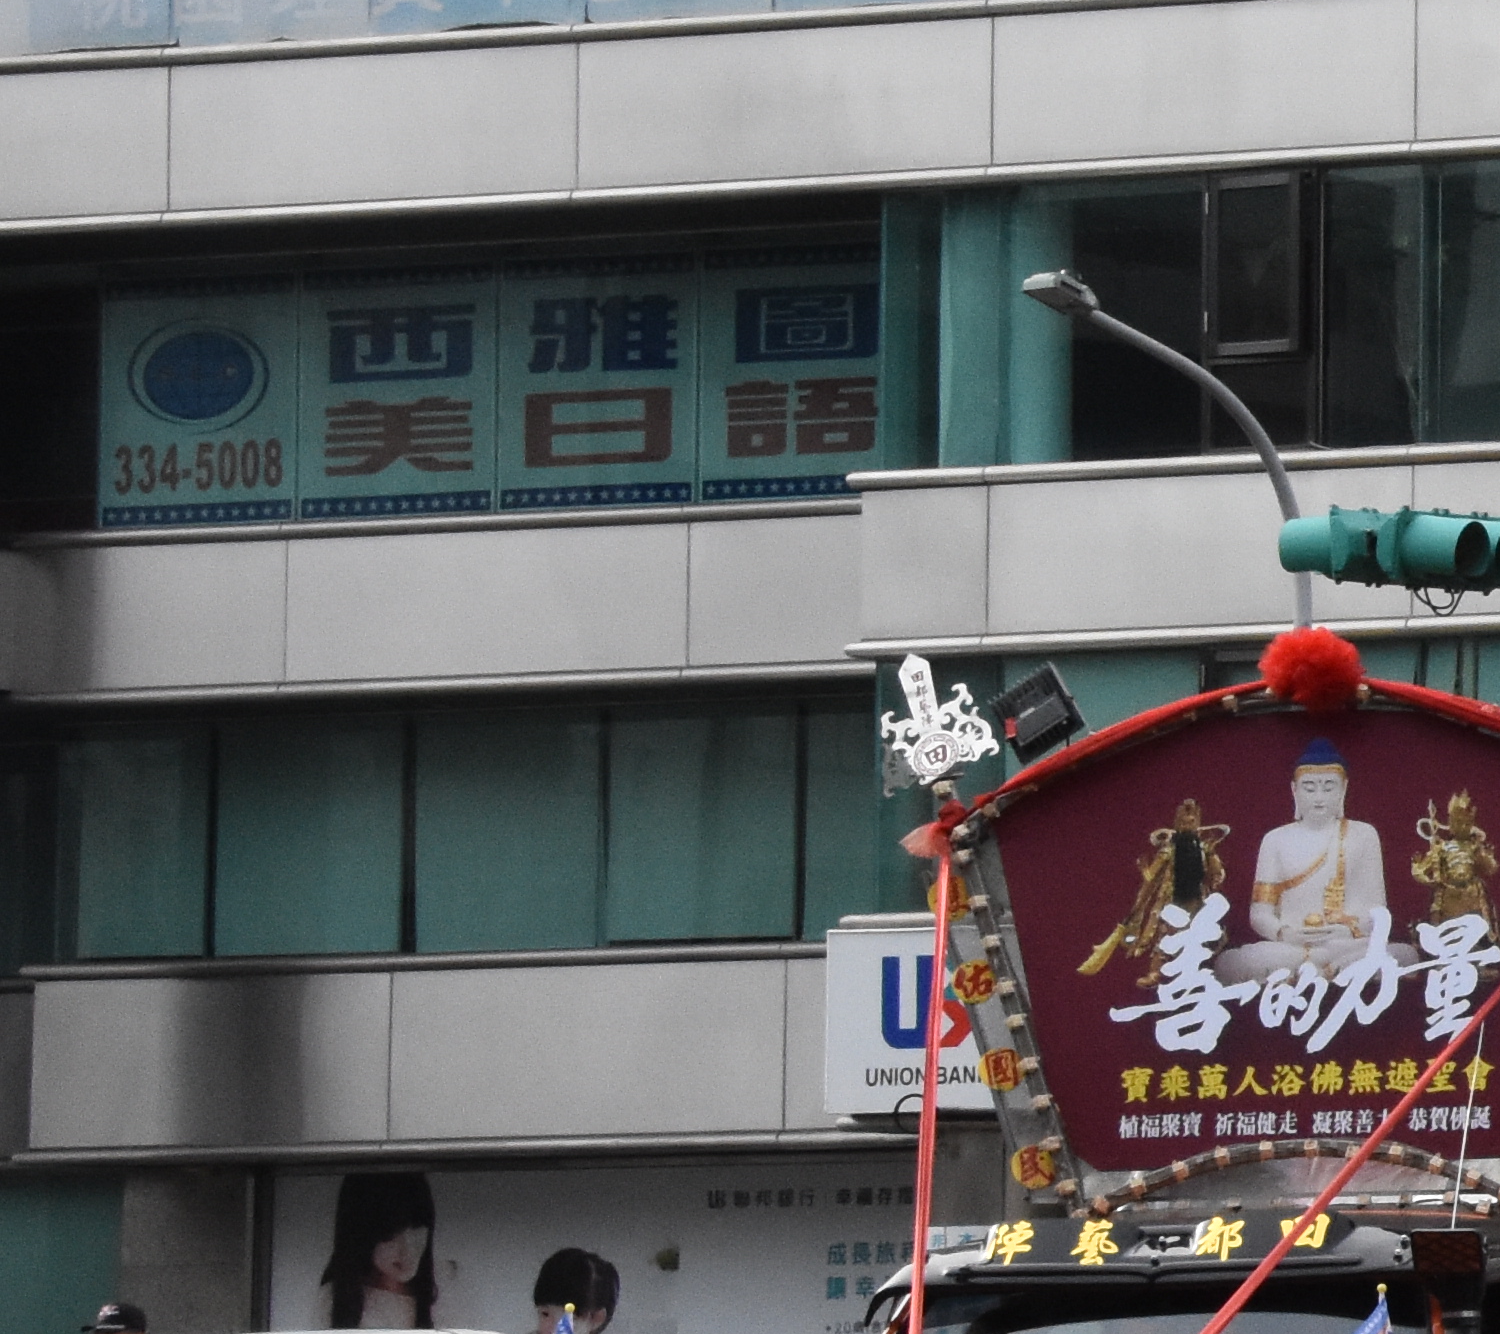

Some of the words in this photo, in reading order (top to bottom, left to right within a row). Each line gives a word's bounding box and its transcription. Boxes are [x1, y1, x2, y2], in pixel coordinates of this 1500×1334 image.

[326, 282, 882, 385] 西雅圖
[324, 376, 881, 478] 美日語
[113, 437, 284, 497] 334-5008
[935, 1065, 982, 1086] BAN
[1214, 1110, 1299, 1138] 祈福健走
[1407, 1104, 1493, 1133] 恭賀佛誕
